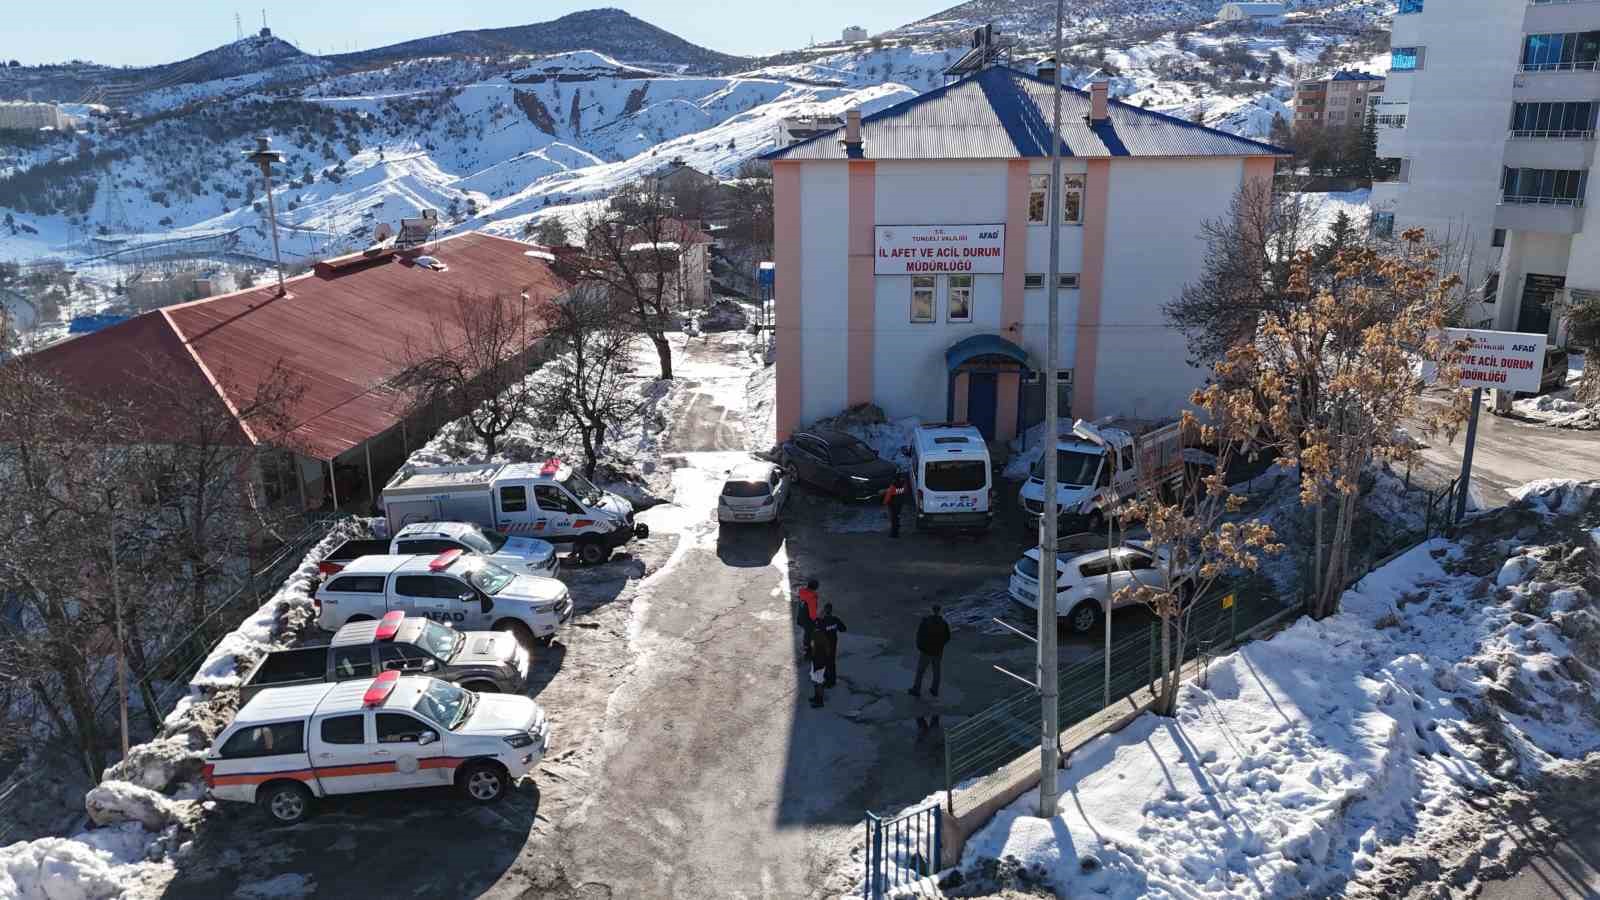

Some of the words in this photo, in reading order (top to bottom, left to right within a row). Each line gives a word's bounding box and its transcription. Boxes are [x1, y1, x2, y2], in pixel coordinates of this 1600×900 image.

[979, 231, 998, 239] AFAD
[879, 246, 888, 257] İL
[891, 248, 917, 257] AFET
[920, 248, 934, 257] VE
[936, 246, 960, 257] ACİL
[963, 247, 1001, 257] DURUM
[906, 260, 972, 271] MÜDÜRLÜĞÜ
[1512, 344, 1535, 352] AFAD
[1464, 355, 1478, 365] VE
[1479, 354, 1498, 367] ACİL
[1501, 358, 1534, 370] DURUM
[1460, 367, 1507, 383] ÜDÜRLÜĞÜ
[421, 610, 465, 623] AFAD
